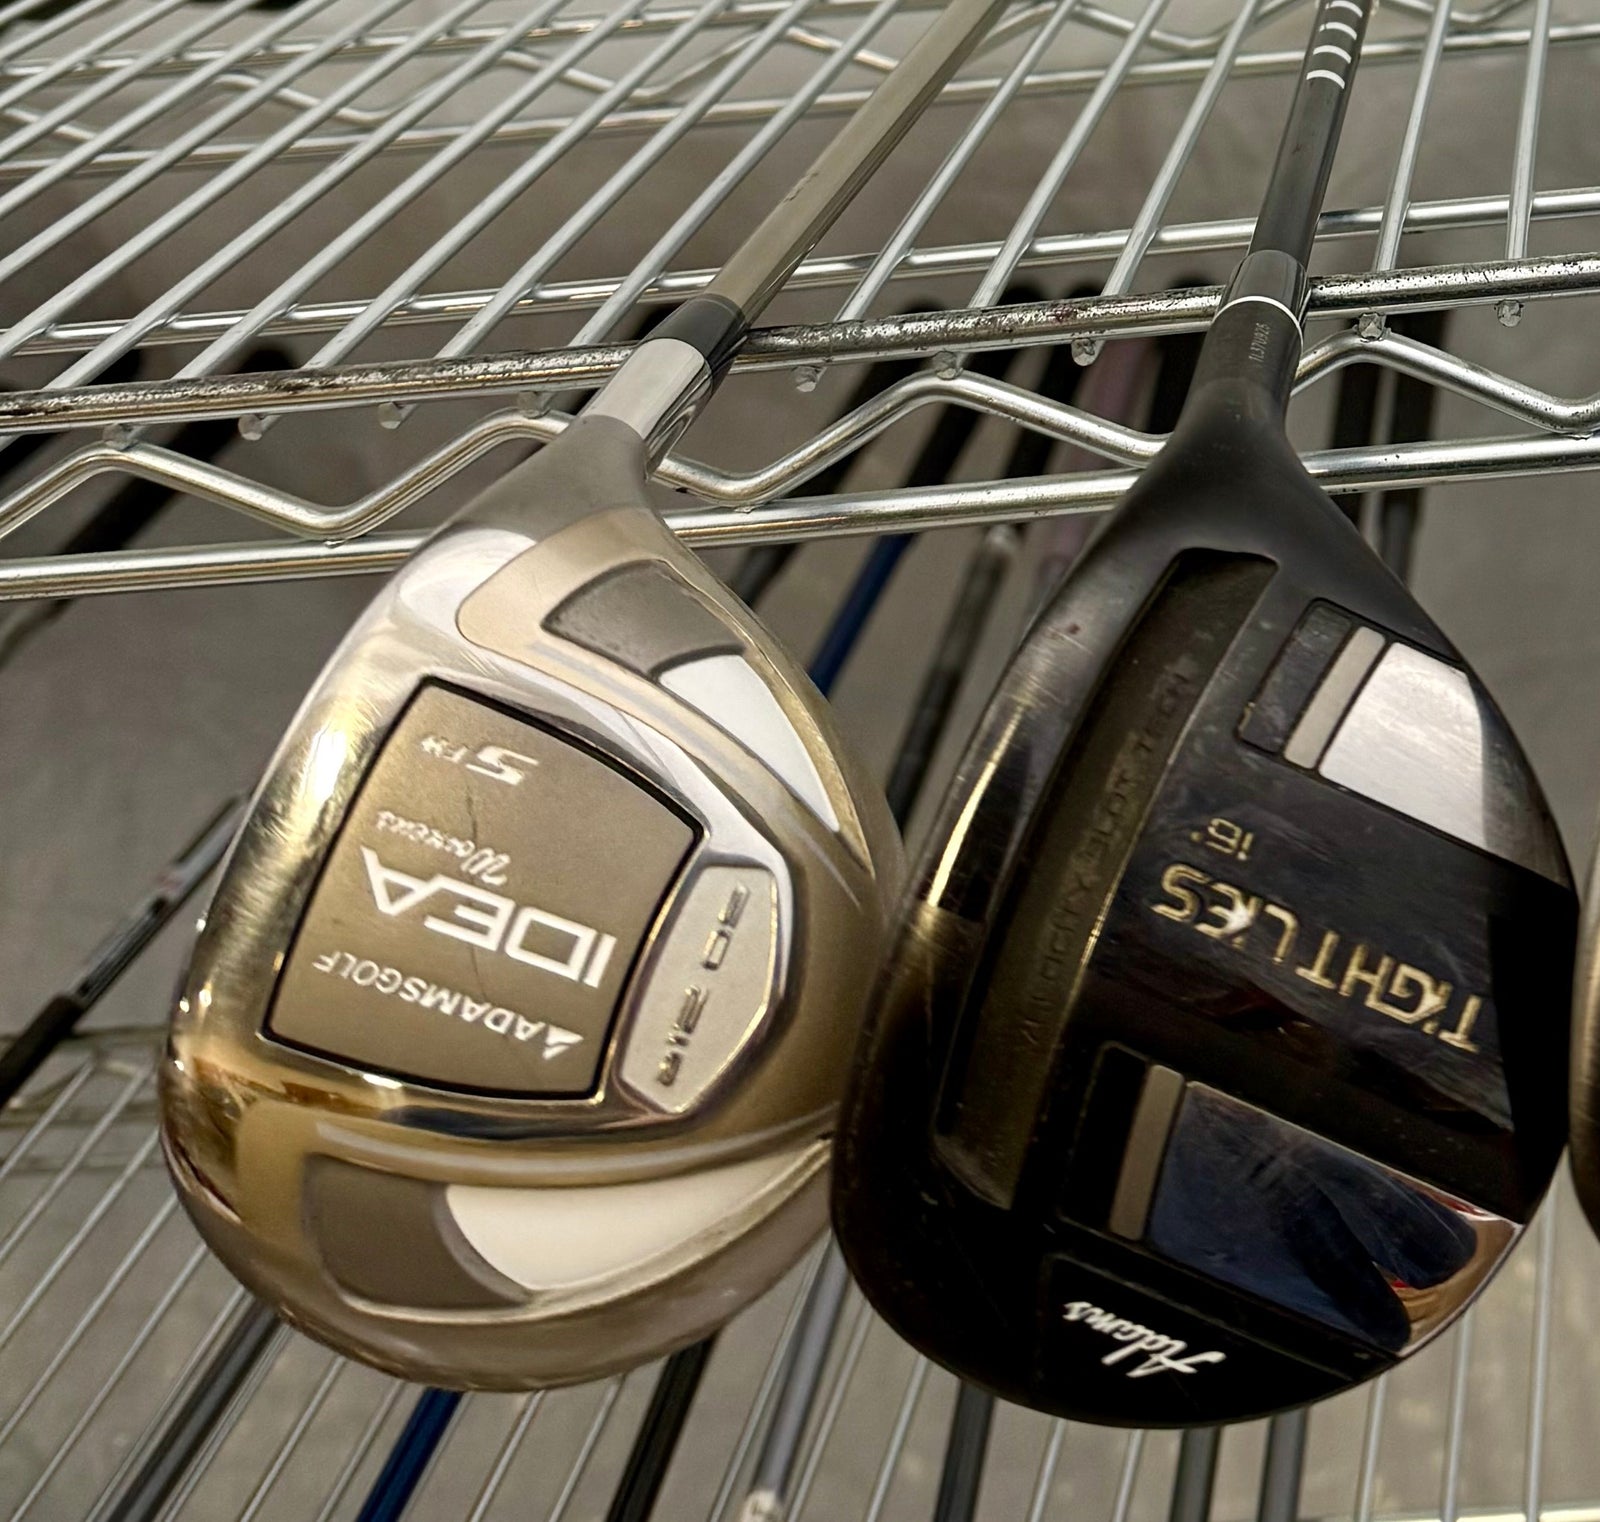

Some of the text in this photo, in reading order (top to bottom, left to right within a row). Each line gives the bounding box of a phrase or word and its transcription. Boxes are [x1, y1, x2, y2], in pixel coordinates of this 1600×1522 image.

[466, 745, 538, 785] 5
[360, 844, 616, 988] IDEA
[1148, 863, 1482, 1053] TIGHT LIES
[312, 951, 549, 1042] ADAMSGOLF
[1062, 1301, 1227, 1378] Adams
